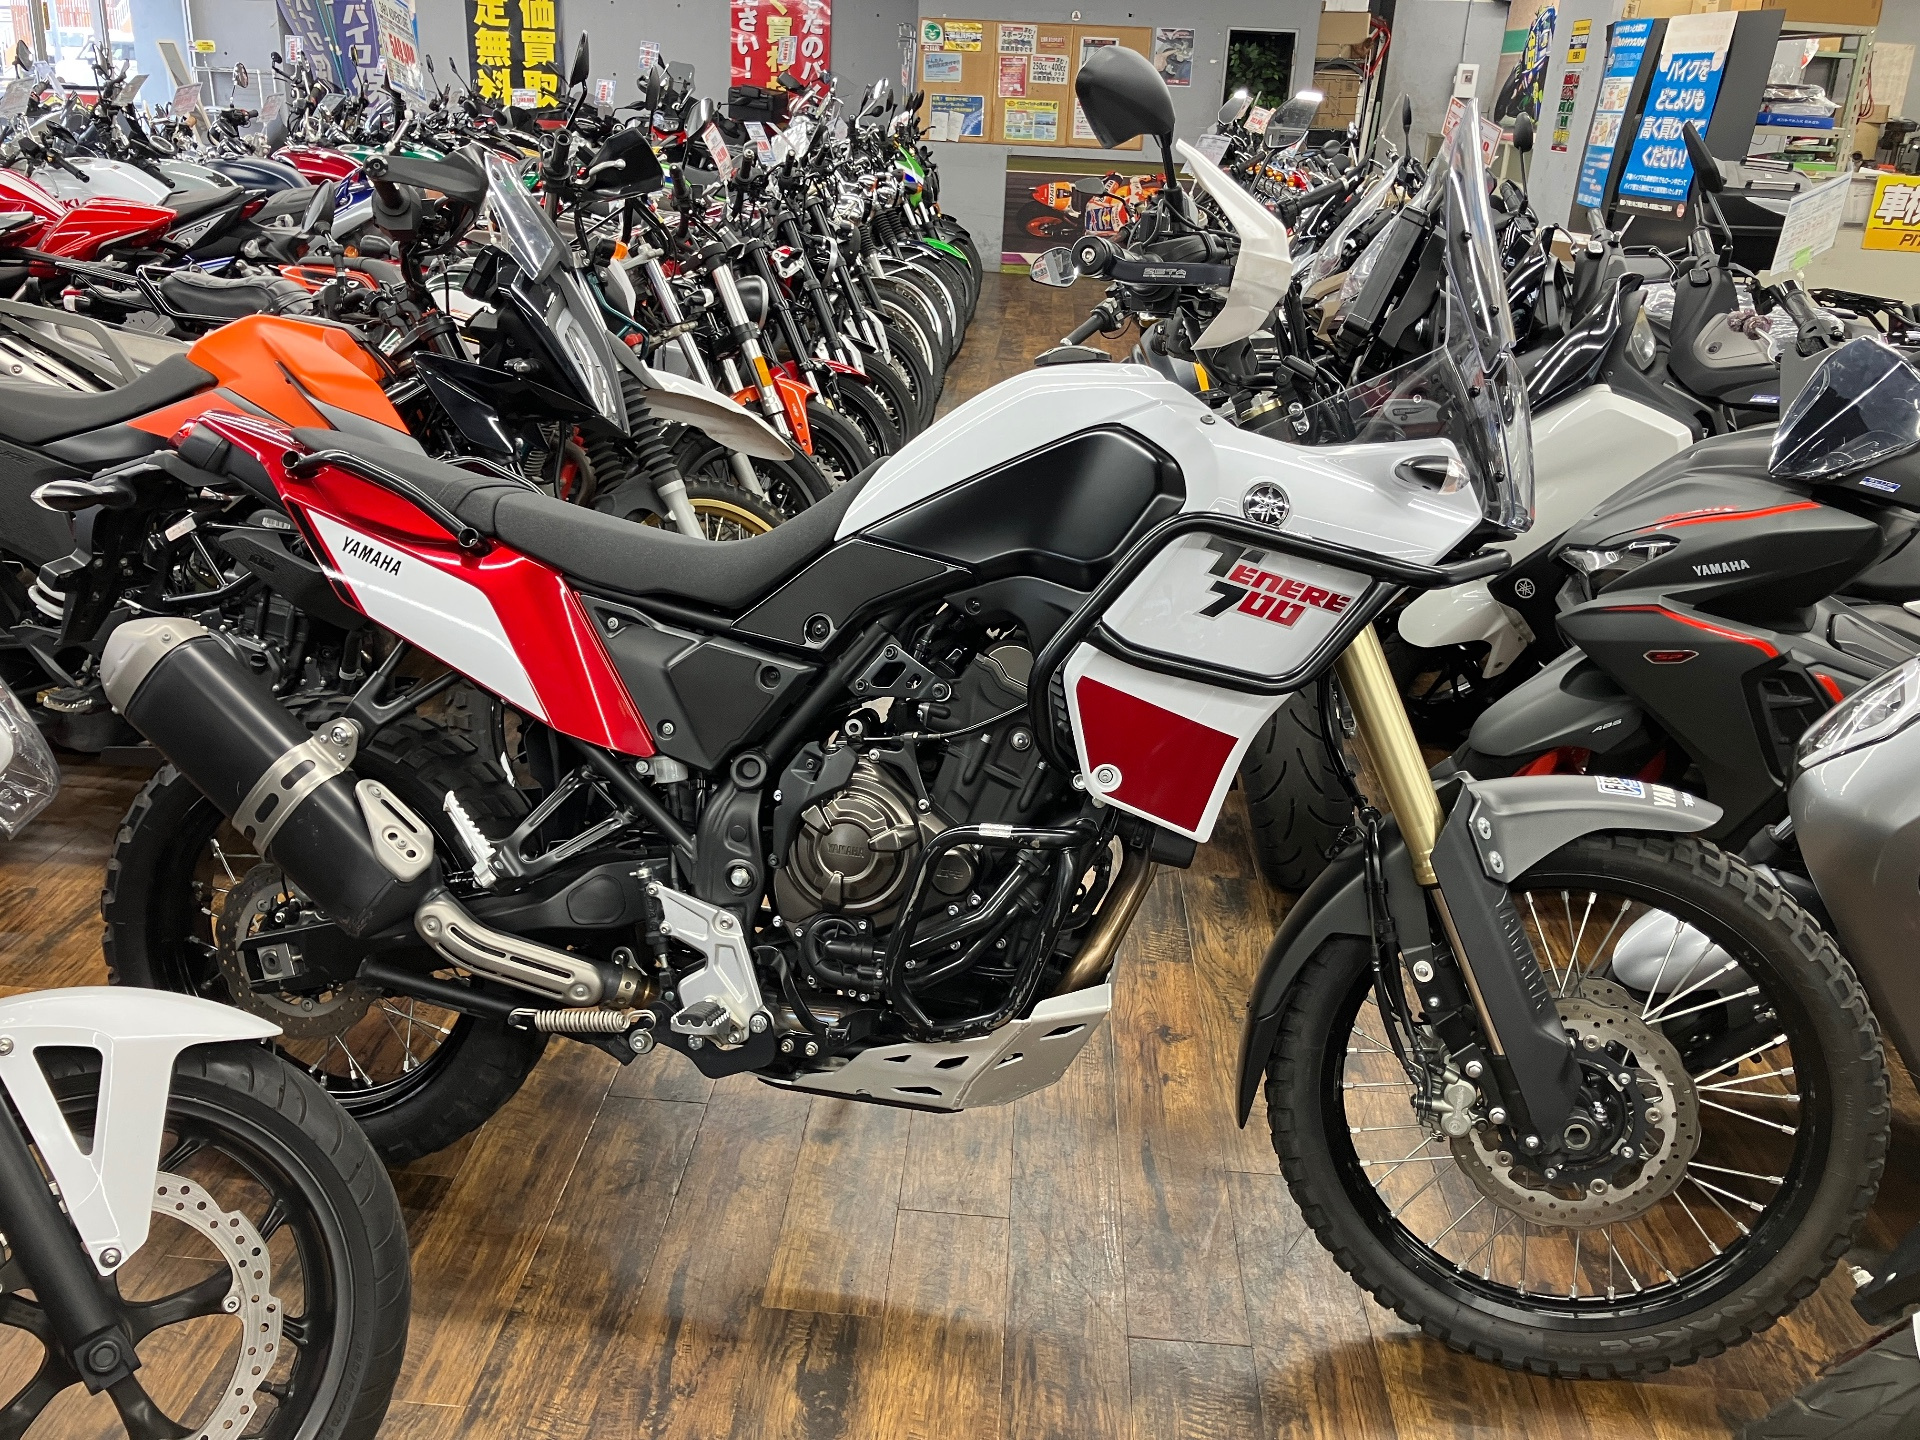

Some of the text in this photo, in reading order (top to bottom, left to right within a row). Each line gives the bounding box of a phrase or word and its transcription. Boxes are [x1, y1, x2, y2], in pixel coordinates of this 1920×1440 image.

[1667, 57, 1713, 82] バイクを
[1655, 87, 1706, 112] どこよりも
[1639, 116, 1706, 141] 高く買わて
[1642, 145, 1689, 169] ください!
[341, 537, 402, 577] YAMAHA
[1692, 559, 1750, 577] YAMAHA
[1198, 580, 1309, 627] 700
[827, 843, 865, 858] YAMAHA
